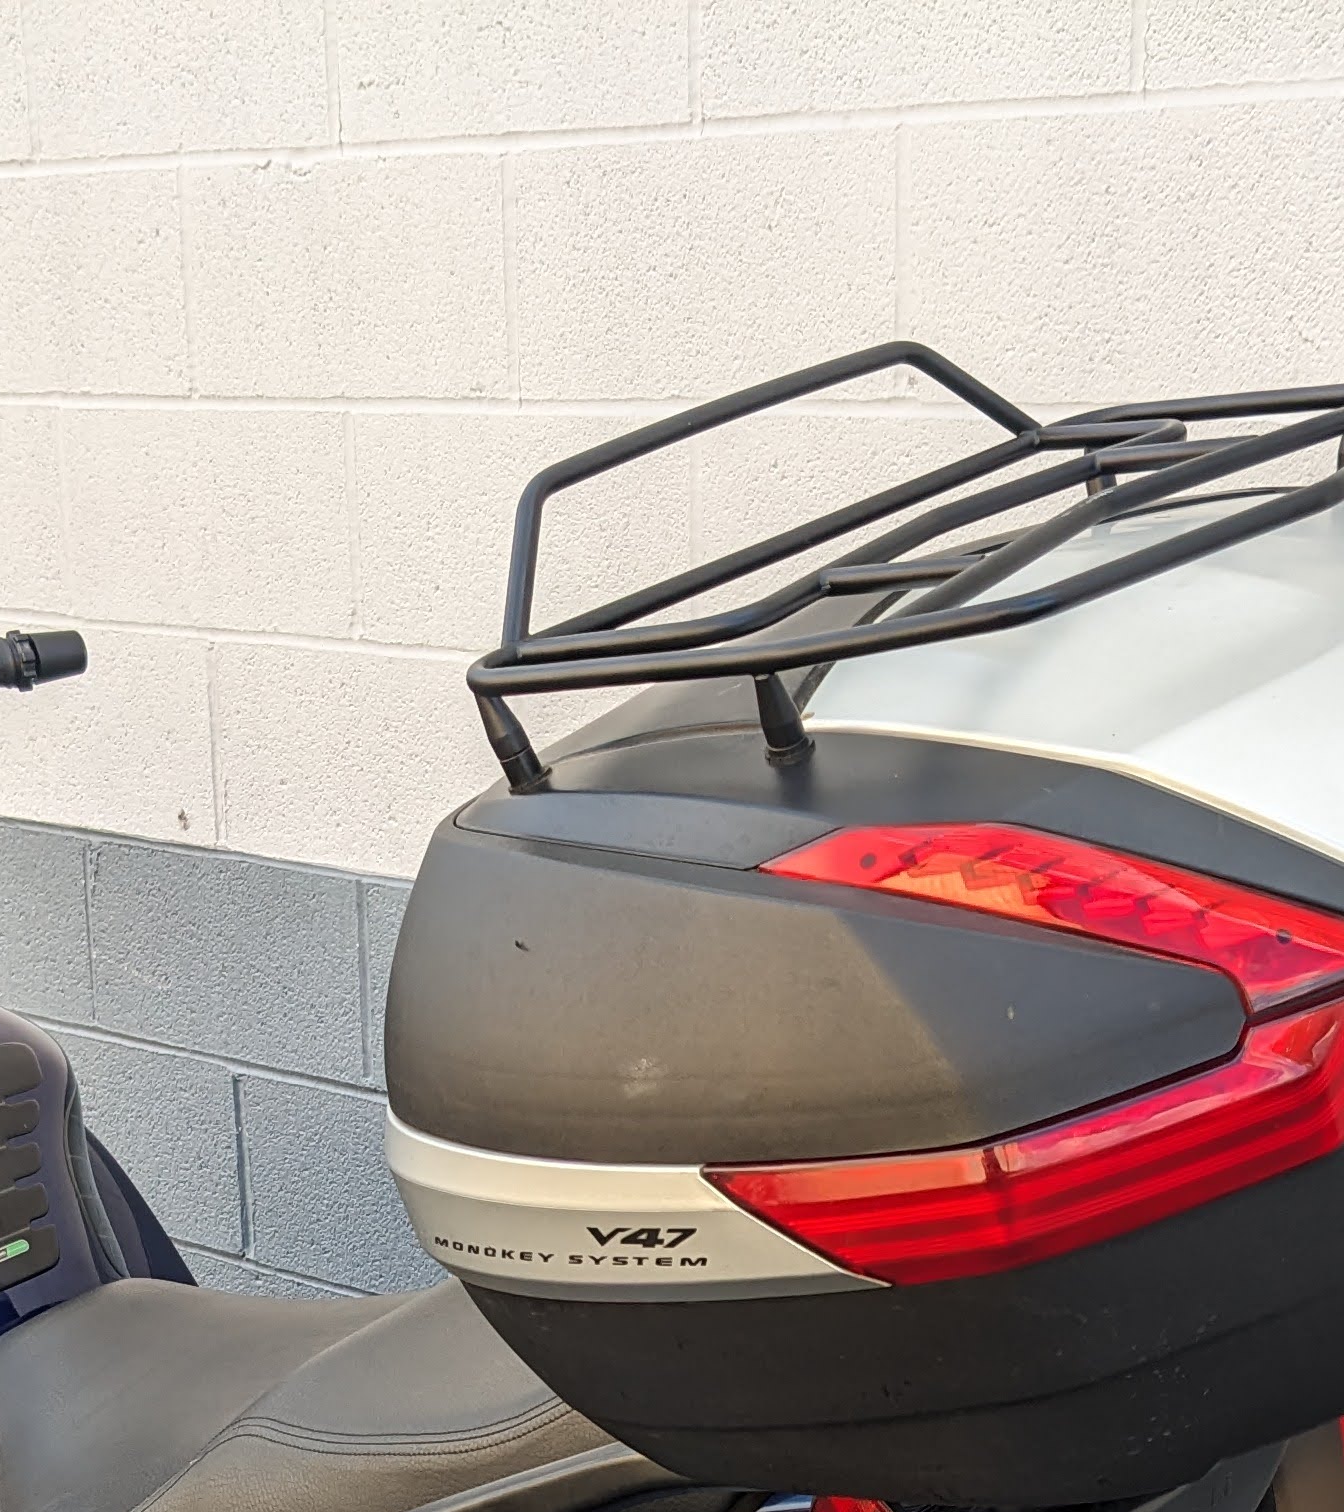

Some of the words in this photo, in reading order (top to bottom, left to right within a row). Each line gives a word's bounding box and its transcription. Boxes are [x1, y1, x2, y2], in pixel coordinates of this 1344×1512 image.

[586, 1226, 698, 1249] V47
[434, 1236, 555, 1263] MONOKEY
[568, 1254, 708, 1267] SYSTEM
